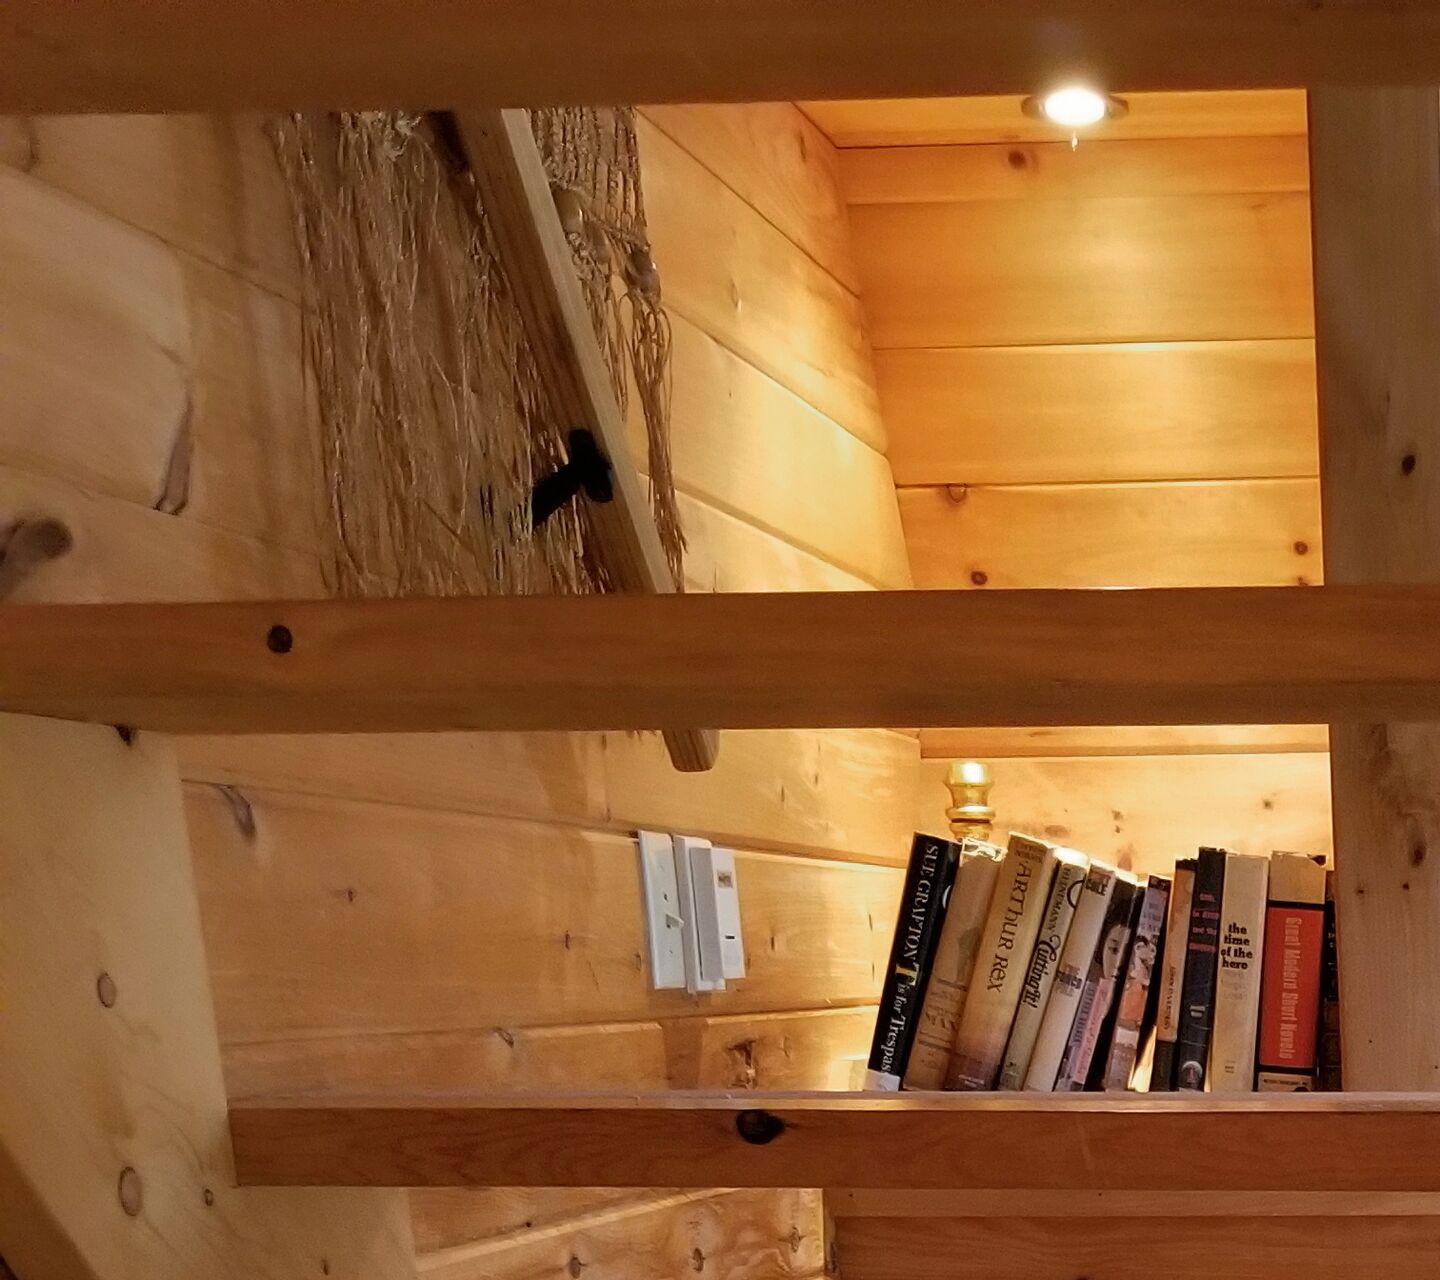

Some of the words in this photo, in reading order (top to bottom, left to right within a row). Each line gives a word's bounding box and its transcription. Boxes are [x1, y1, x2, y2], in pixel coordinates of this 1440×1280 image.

[920, 846, 938, 877] SUE
[903, 879, 931, 960] GRAFTON
[1229, 922, 1247, 933] the
[1284, 916, 1302, 946] Great
[1220, 946, 1232, 957] of
[1233, 945, 1253, 960] the
[1224, 934, 1249, 945] time
[1025, 935, 1061, 991] Cutting
[1221, 956, 1249, 970] hero
[1282, 949, 1301, 989] Modern
[893, 994, 907, 1012] for
[1280, 991, 1299, 1023] Short
[881, 1013, 905, 1073] Trespas
[1278, 1023, 1298, 1060] Novels
